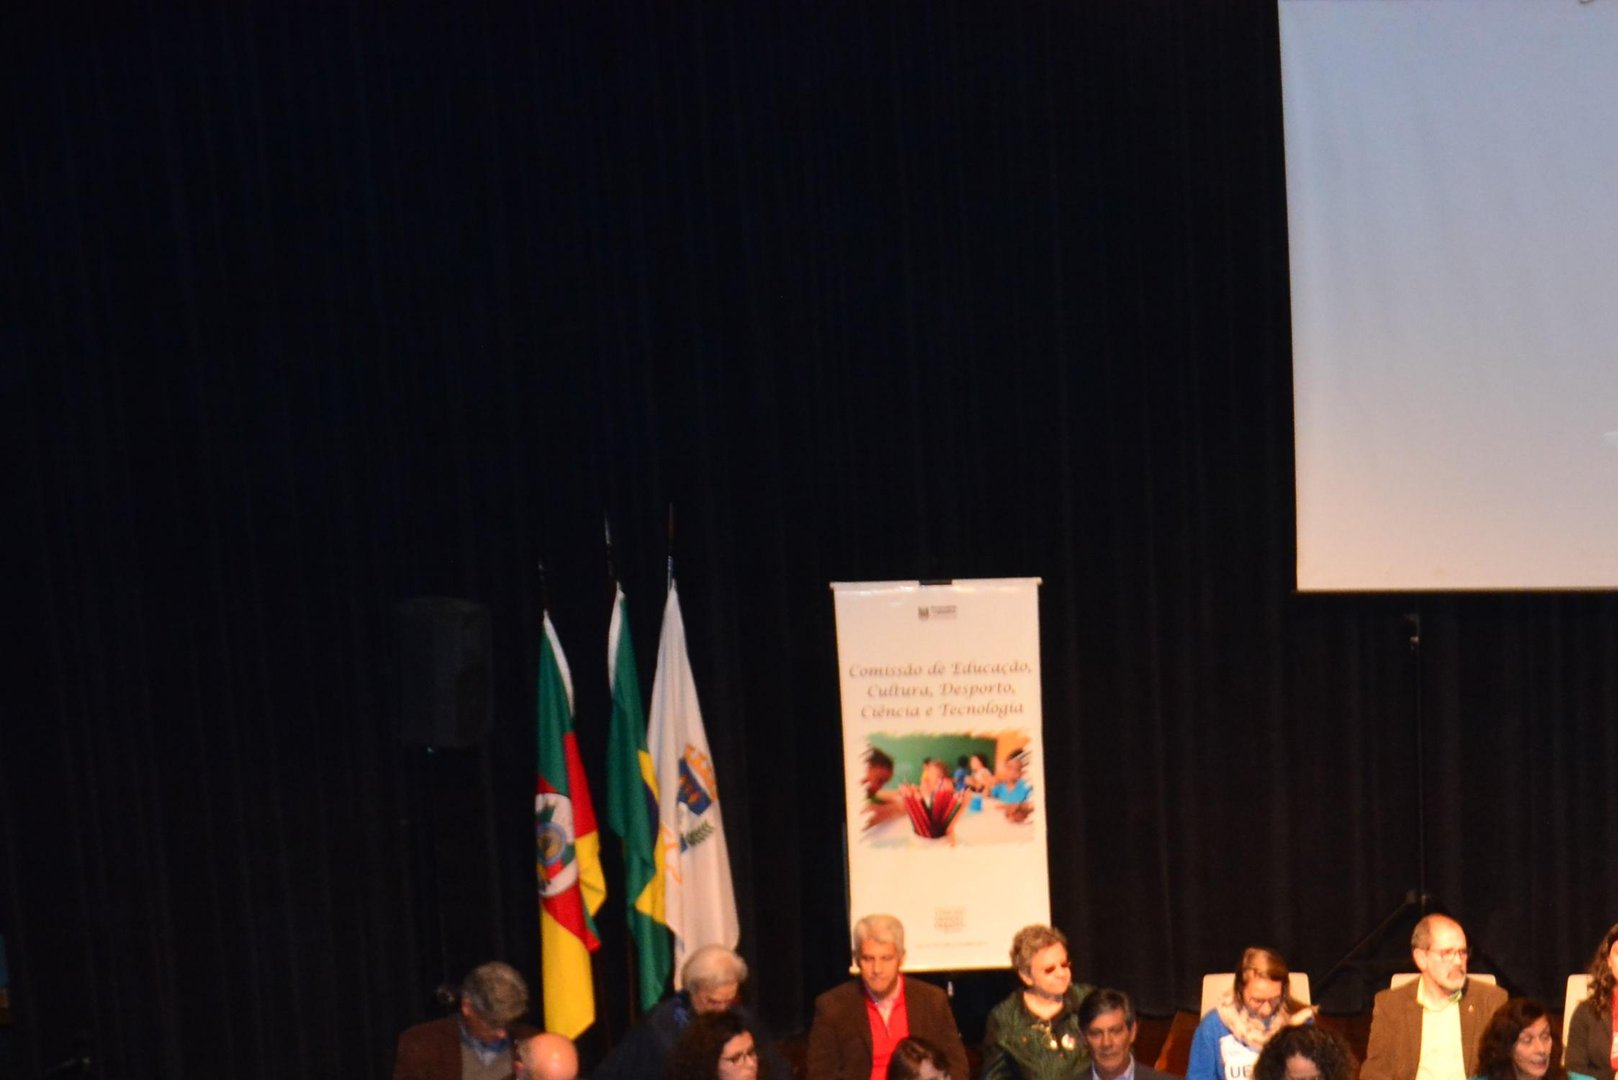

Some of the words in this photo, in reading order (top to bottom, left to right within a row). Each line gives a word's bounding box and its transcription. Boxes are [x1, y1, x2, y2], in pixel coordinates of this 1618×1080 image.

[927, 660, 946, 676] de
[940, 681, 1017, 698] Desporto,
[941, 700, 1024, 719] Tecnologia
